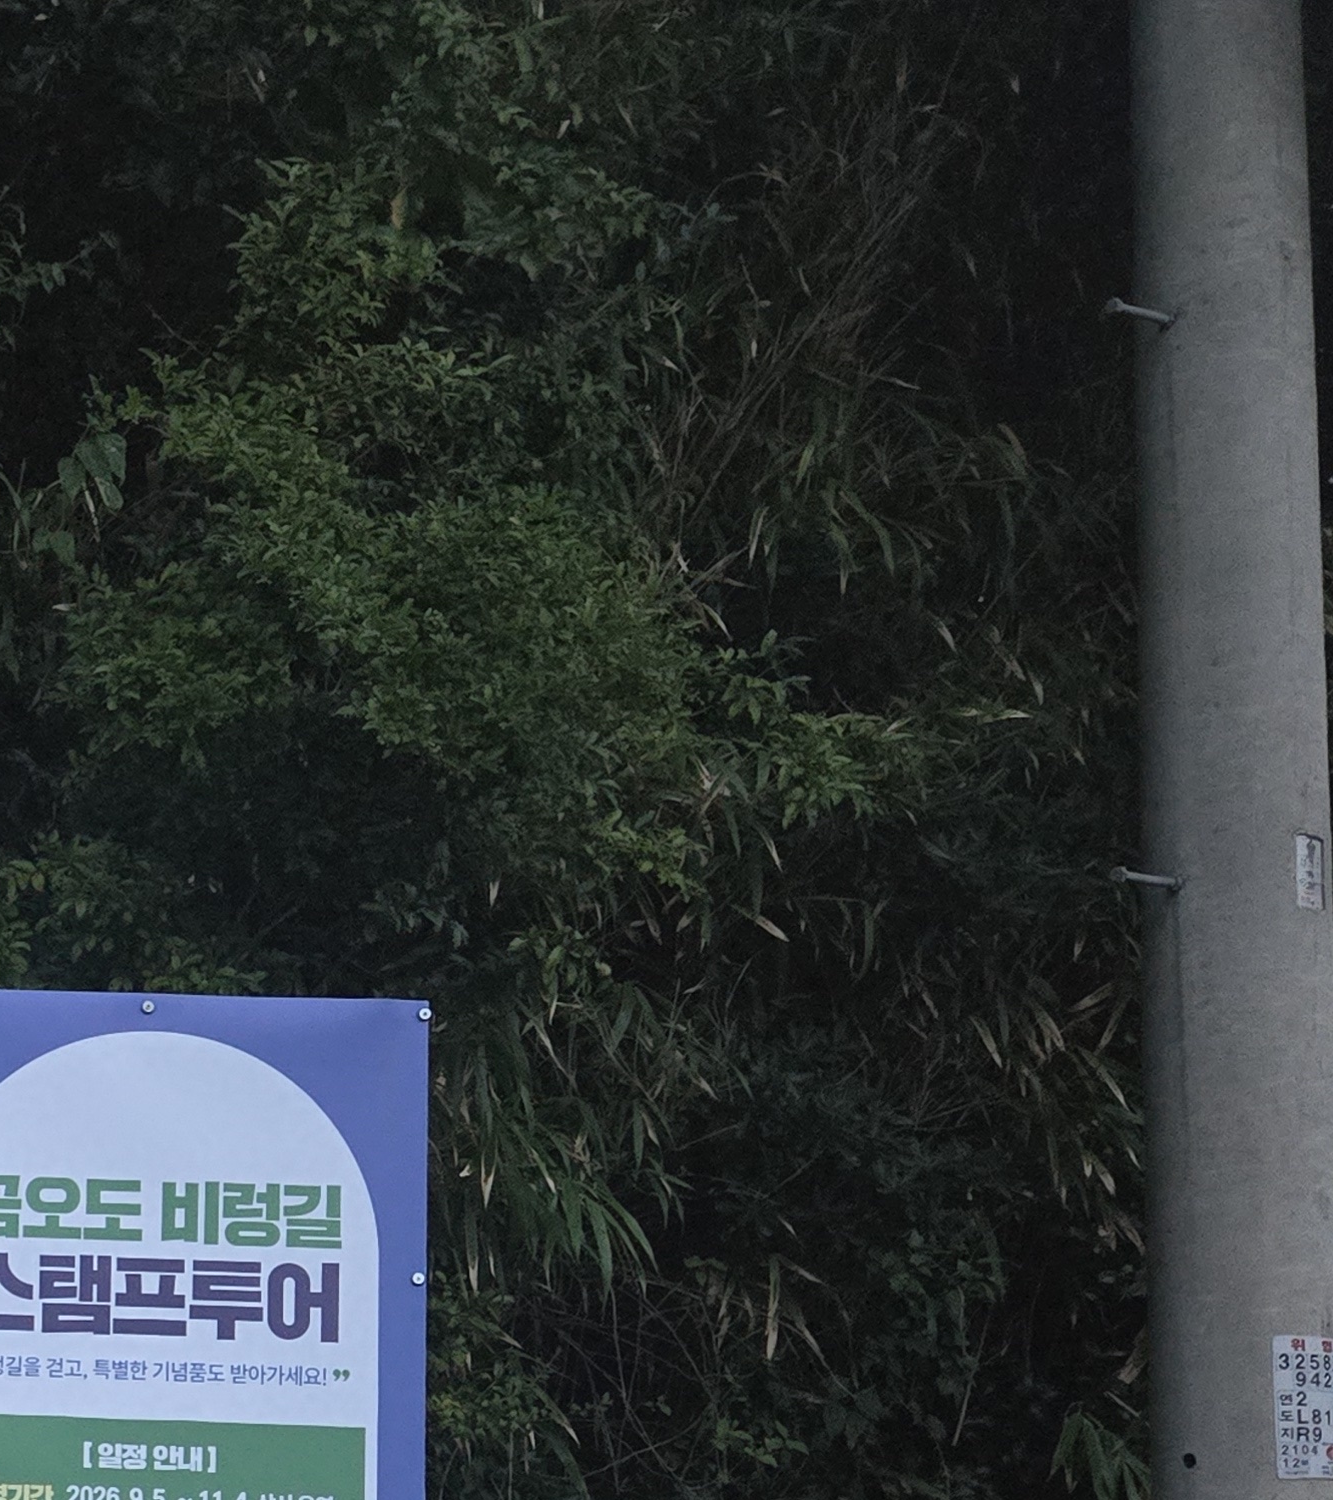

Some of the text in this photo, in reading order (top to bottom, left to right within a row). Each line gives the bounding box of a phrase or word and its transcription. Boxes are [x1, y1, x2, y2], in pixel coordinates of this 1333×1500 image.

[161, 1181, 342, 1249] 비렁길
[98, 1443, 204, 1471] 일정 안내
